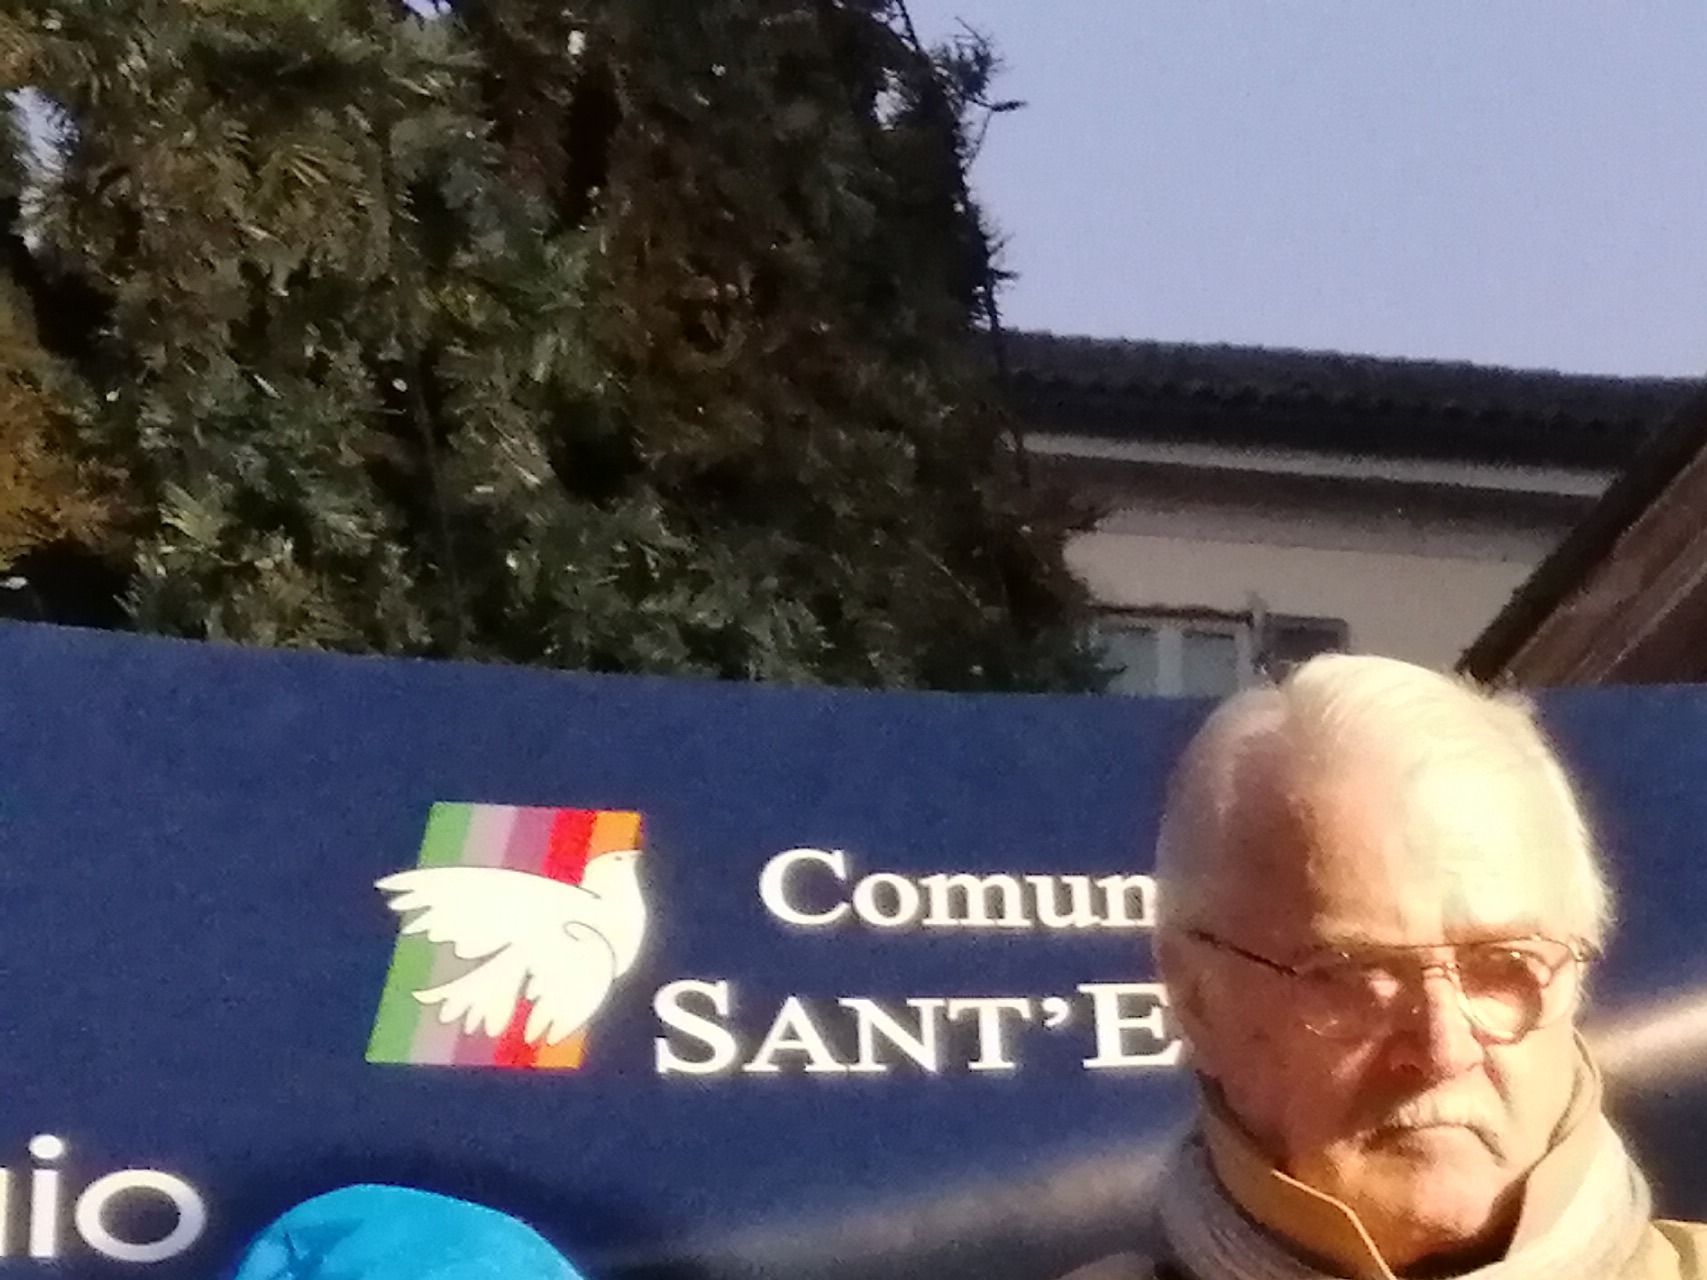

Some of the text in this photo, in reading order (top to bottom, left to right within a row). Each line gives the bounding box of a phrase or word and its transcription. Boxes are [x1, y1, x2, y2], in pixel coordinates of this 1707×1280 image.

[758, 847, 1158, 927] Comun
[652, 978, 1184, 1074] SANT'E
[0, 1134, 206, 1262] io
